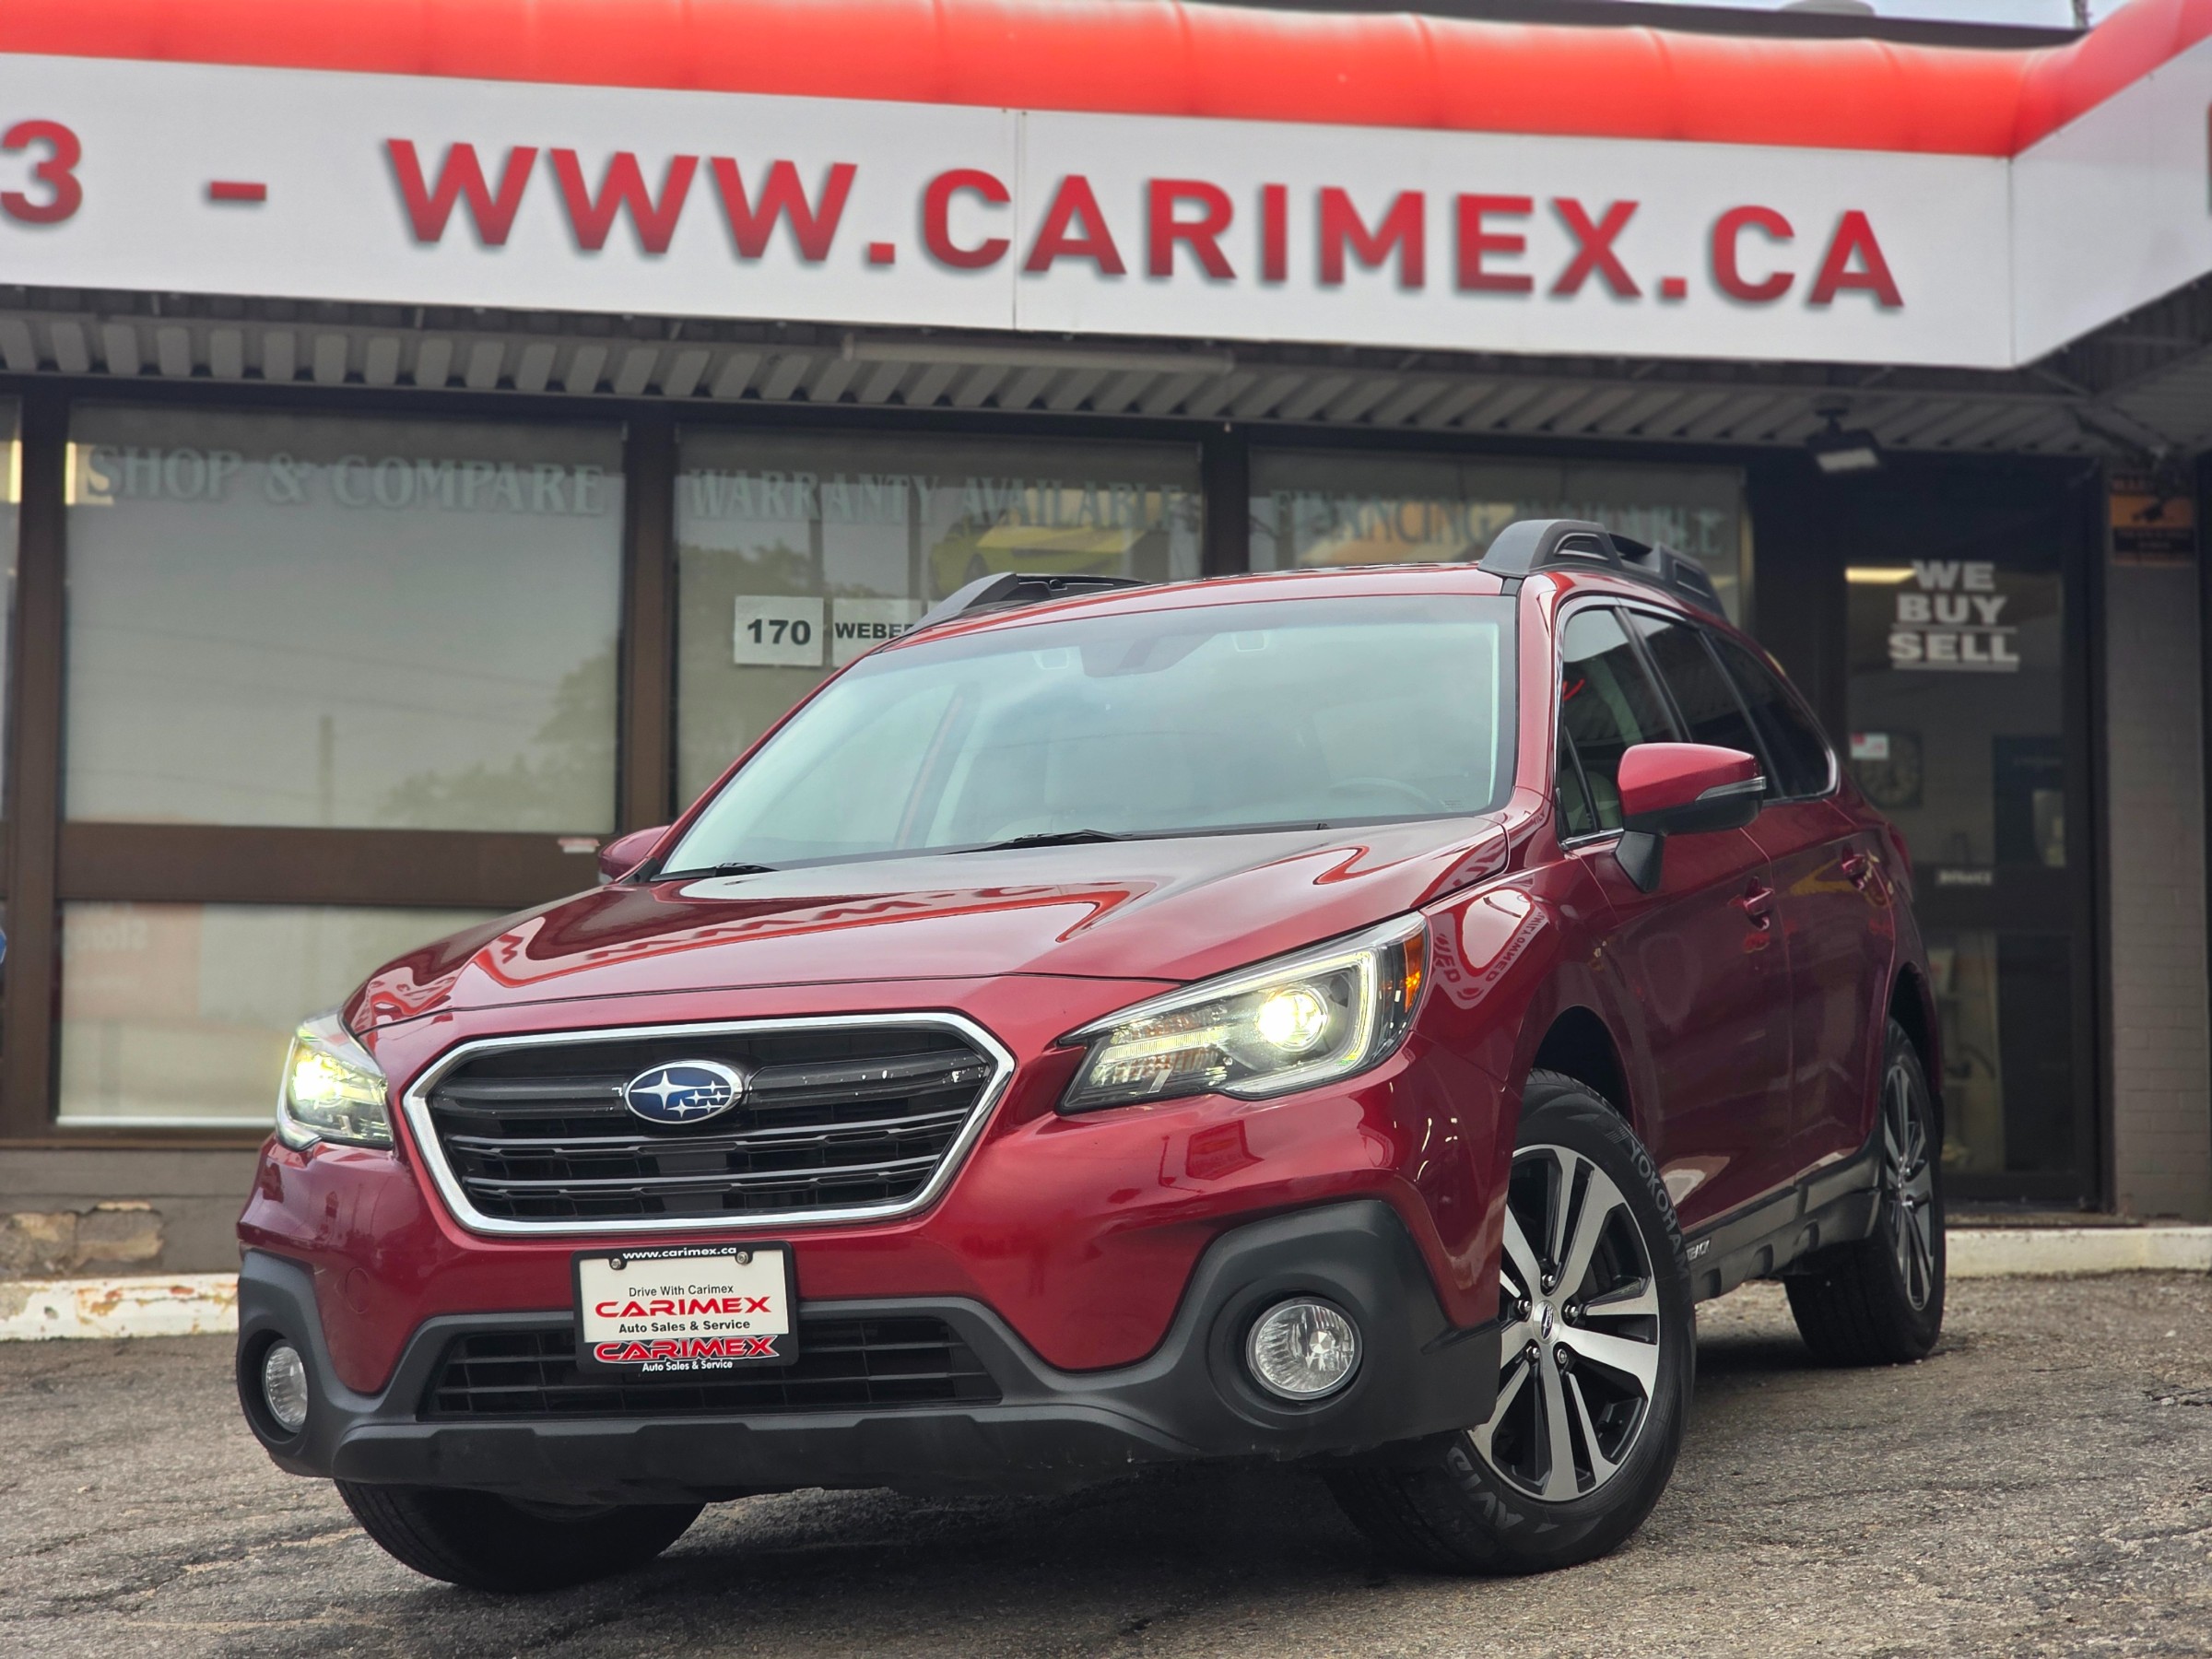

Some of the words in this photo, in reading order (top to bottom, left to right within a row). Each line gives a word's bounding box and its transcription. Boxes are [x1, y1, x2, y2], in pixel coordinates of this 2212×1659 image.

[383, 136, 1904, 308] WWW.CARIMEX.CA
[88, 444, 241, 503] SHOP
[265, 450, 310, 503] &
[331, 455, 606, 516] COMPARE
[687, 468, 940, 524] WARRANTY
[1911, 559, 1994, 591] WE
[1897, 594, 2007, 625] BUY
[746, 618, 812, 645] 170
[1888, 632, 2020, 664] SELL
[622, 1246, 737, 1260] www.carimex.ca
[629, 1287, 657, 1298] Drive
[660, 1286, 685, 1296] With
[688, 1284, 734, 1295] Carimex
[594, 1296, 772, 1318] CARIMEX
[618, 1324, 647, 1334] Auto
[651, 1322, 686, 1333] Sales
[689, 1321, 700, 1331] &
[703, 1320, 751, 1330] Service
[594, 1335, 780, 1363] CARIMEX
[641, 1361, 664, 1371] Auto
[665, 1360, 690, 1371] Sales
[691, 1360, 699, 1370] &
[700, 1359, 734, 1370] Service
